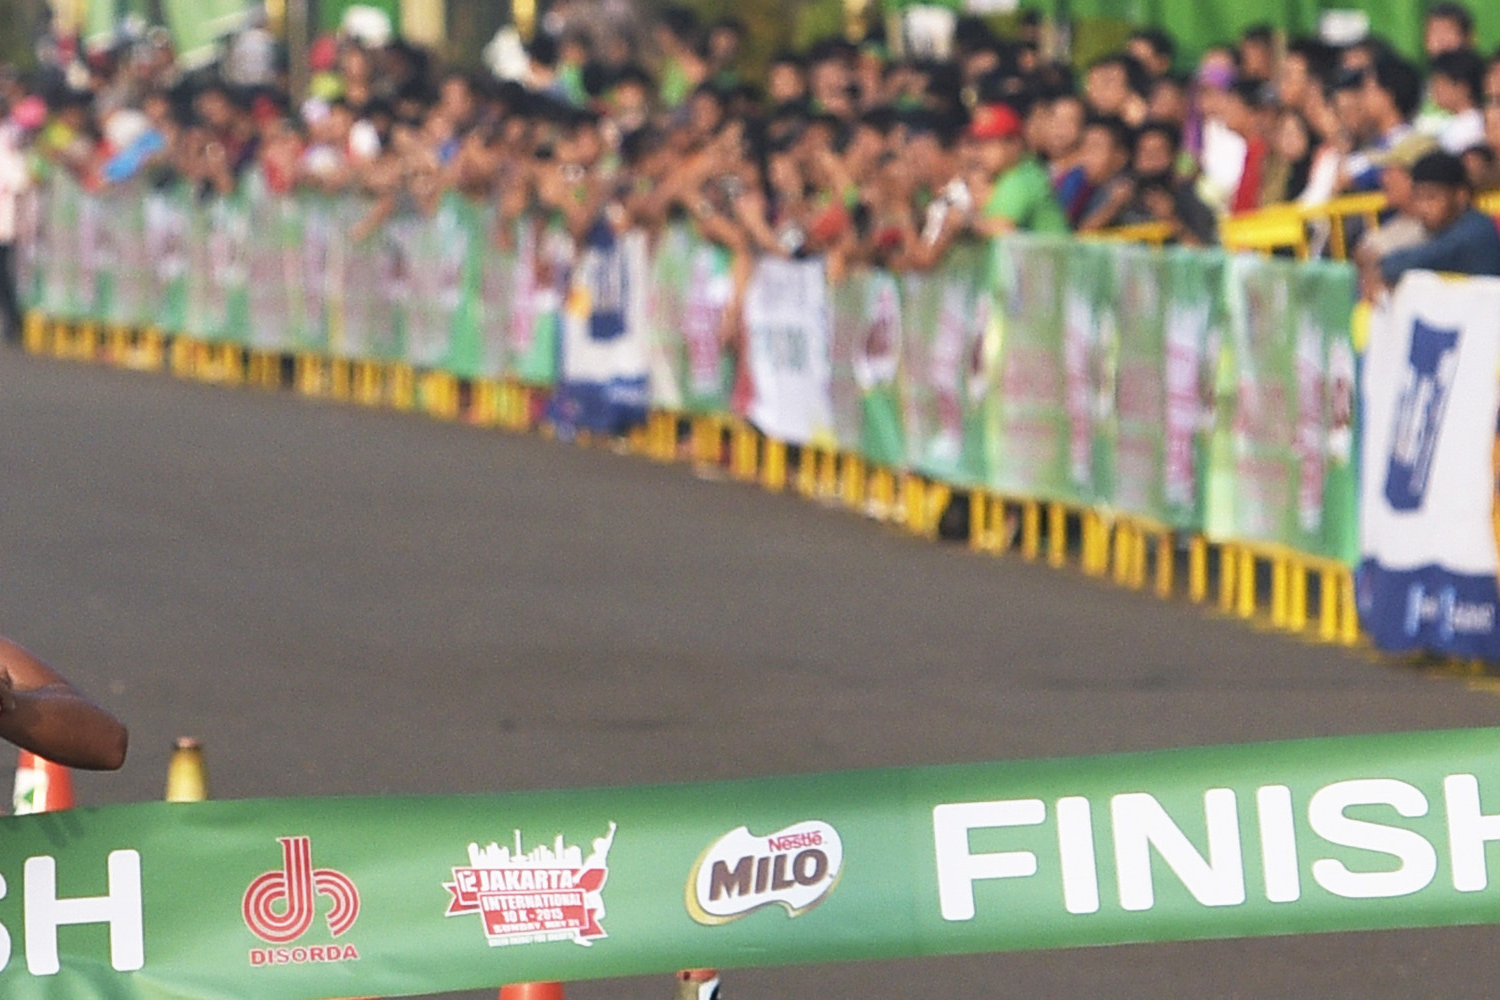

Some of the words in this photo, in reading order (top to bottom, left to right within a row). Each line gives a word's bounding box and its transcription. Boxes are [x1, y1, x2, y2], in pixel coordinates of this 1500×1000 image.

[457, 871, 478, 892] 12
[480, 869, 573, 892] JAKARTA
[709, 849, 828, 902] MILO
[481, 893, 583, 912] INTERNATIONAL
[536, 907, 564, 921] 2015
[250, 944, 358, 966] DISORDA
